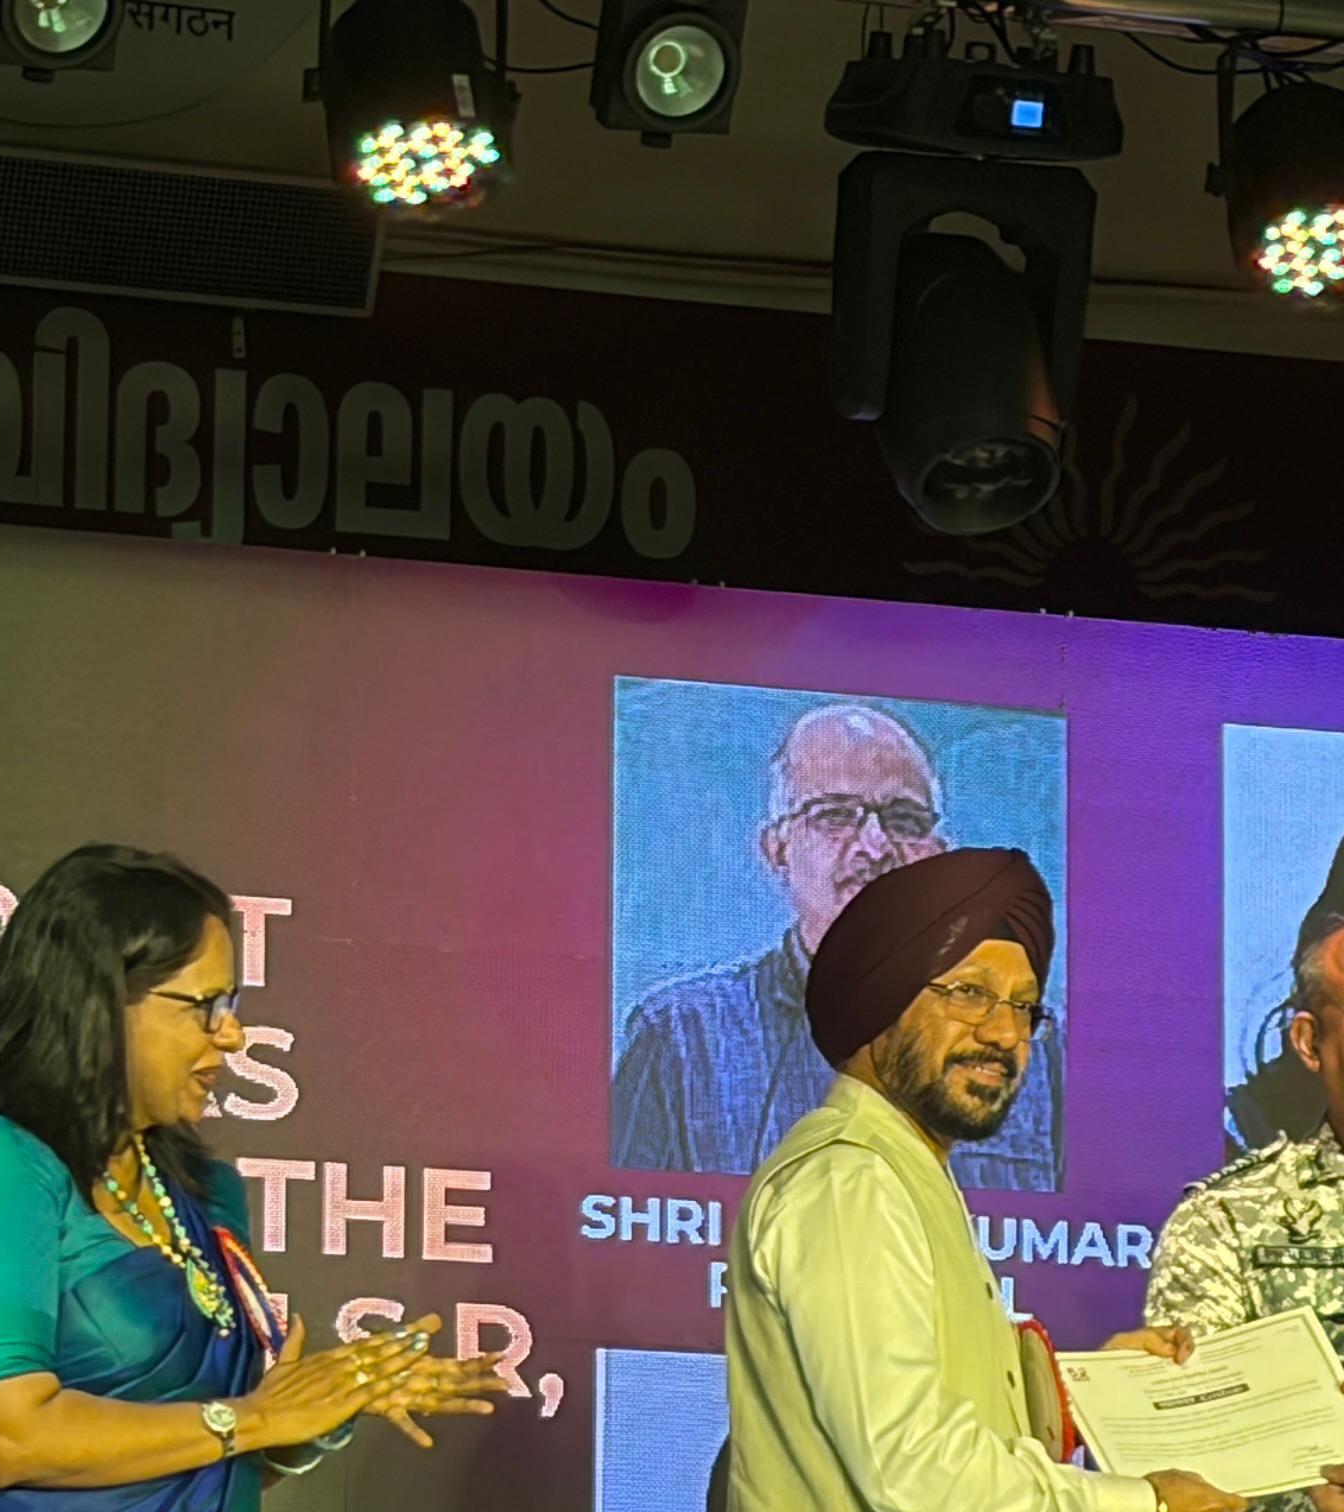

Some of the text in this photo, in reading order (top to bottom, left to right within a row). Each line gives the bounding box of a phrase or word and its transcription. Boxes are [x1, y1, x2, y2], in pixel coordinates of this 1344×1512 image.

[236, 1157, 494, 1264] THE
[580, 1194, 1155, 1269] SHRI UMAR
